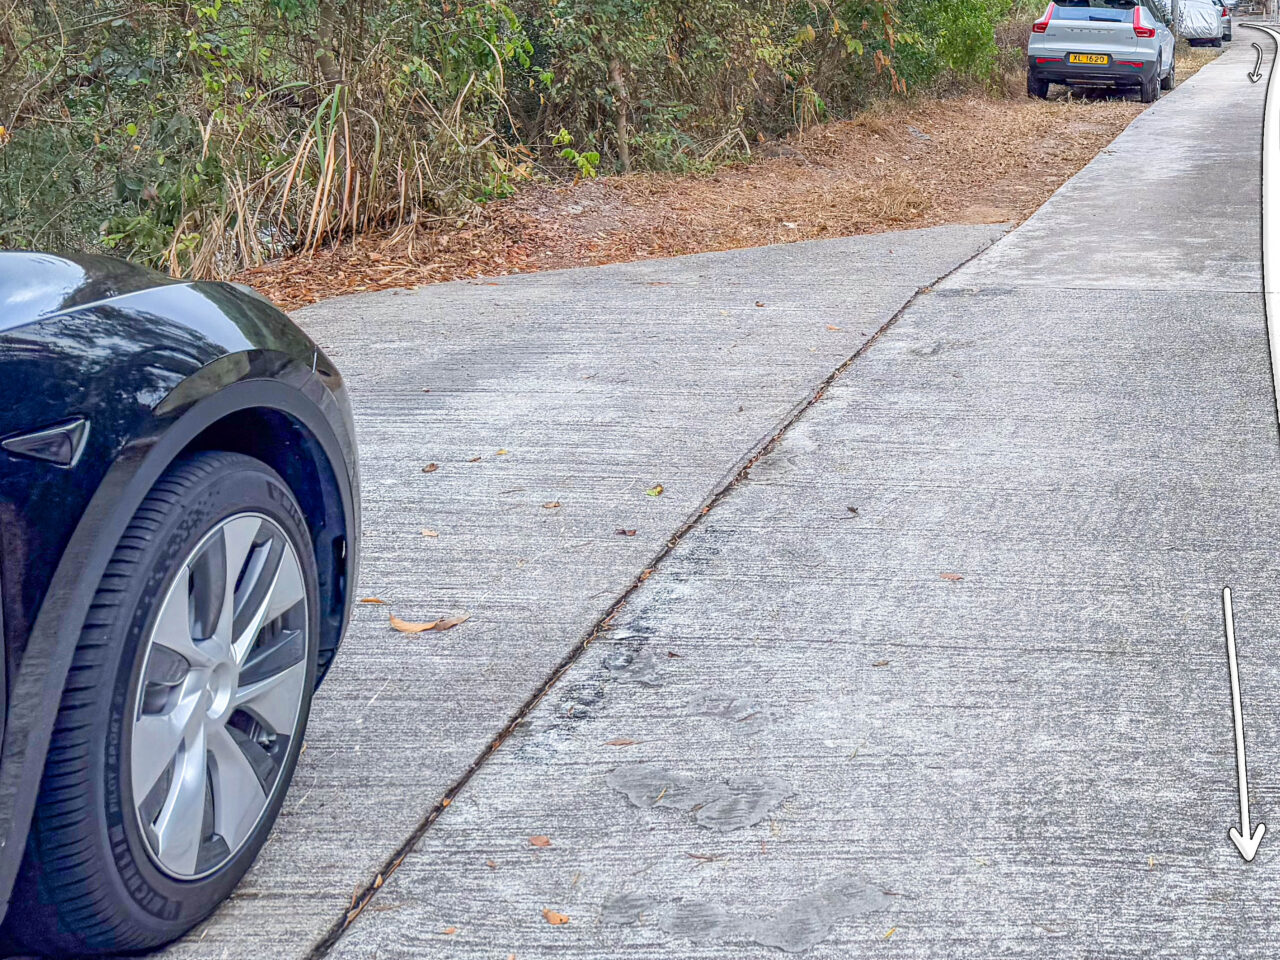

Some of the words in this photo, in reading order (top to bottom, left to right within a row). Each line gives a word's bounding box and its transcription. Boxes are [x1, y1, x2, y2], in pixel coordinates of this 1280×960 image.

[1073, 54, 1082, 62] XL
[1086, 55, 1105, 63] 1620
[108, 710, 123, 764] SPORT
